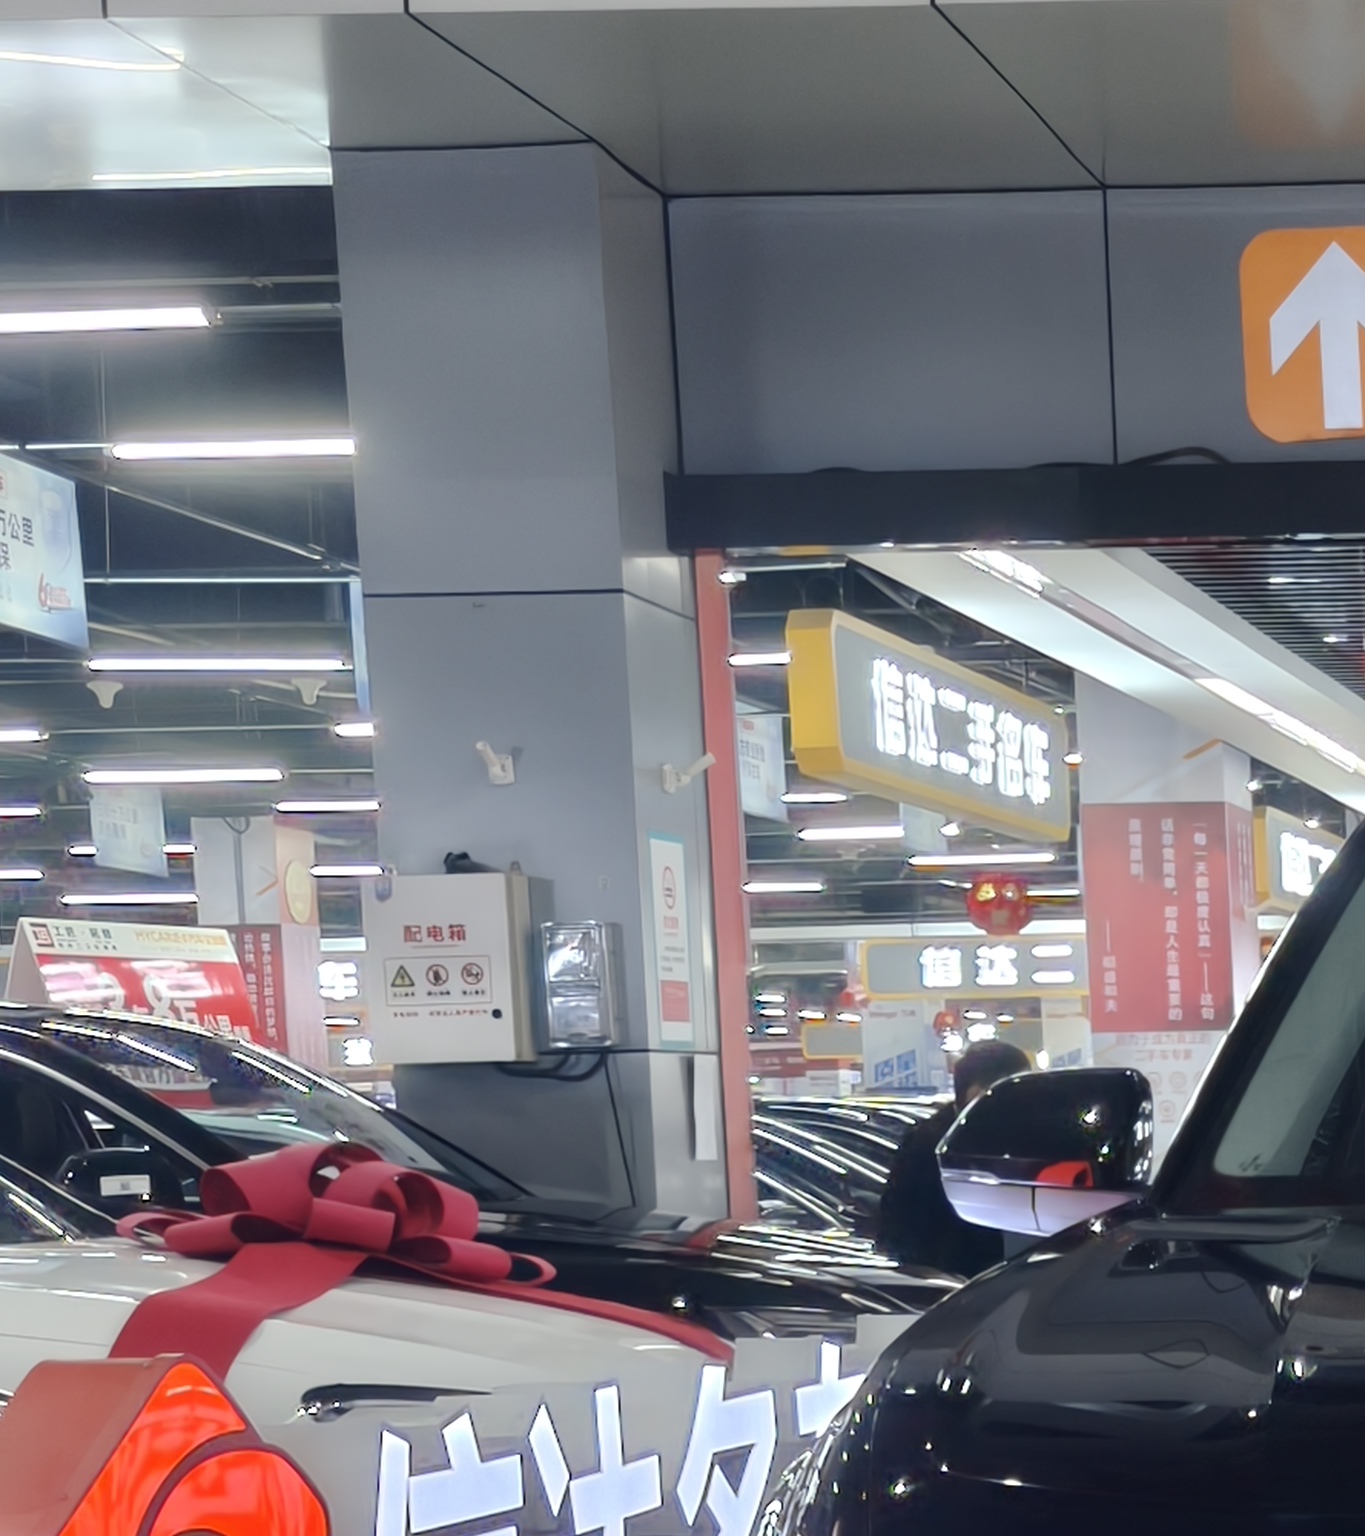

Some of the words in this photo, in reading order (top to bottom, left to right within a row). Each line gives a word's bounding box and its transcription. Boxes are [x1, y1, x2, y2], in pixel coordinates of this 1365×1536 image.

[870, 658, 1051, 805] 信达二手名车
[403, 924, 467, 943] 配电箱
